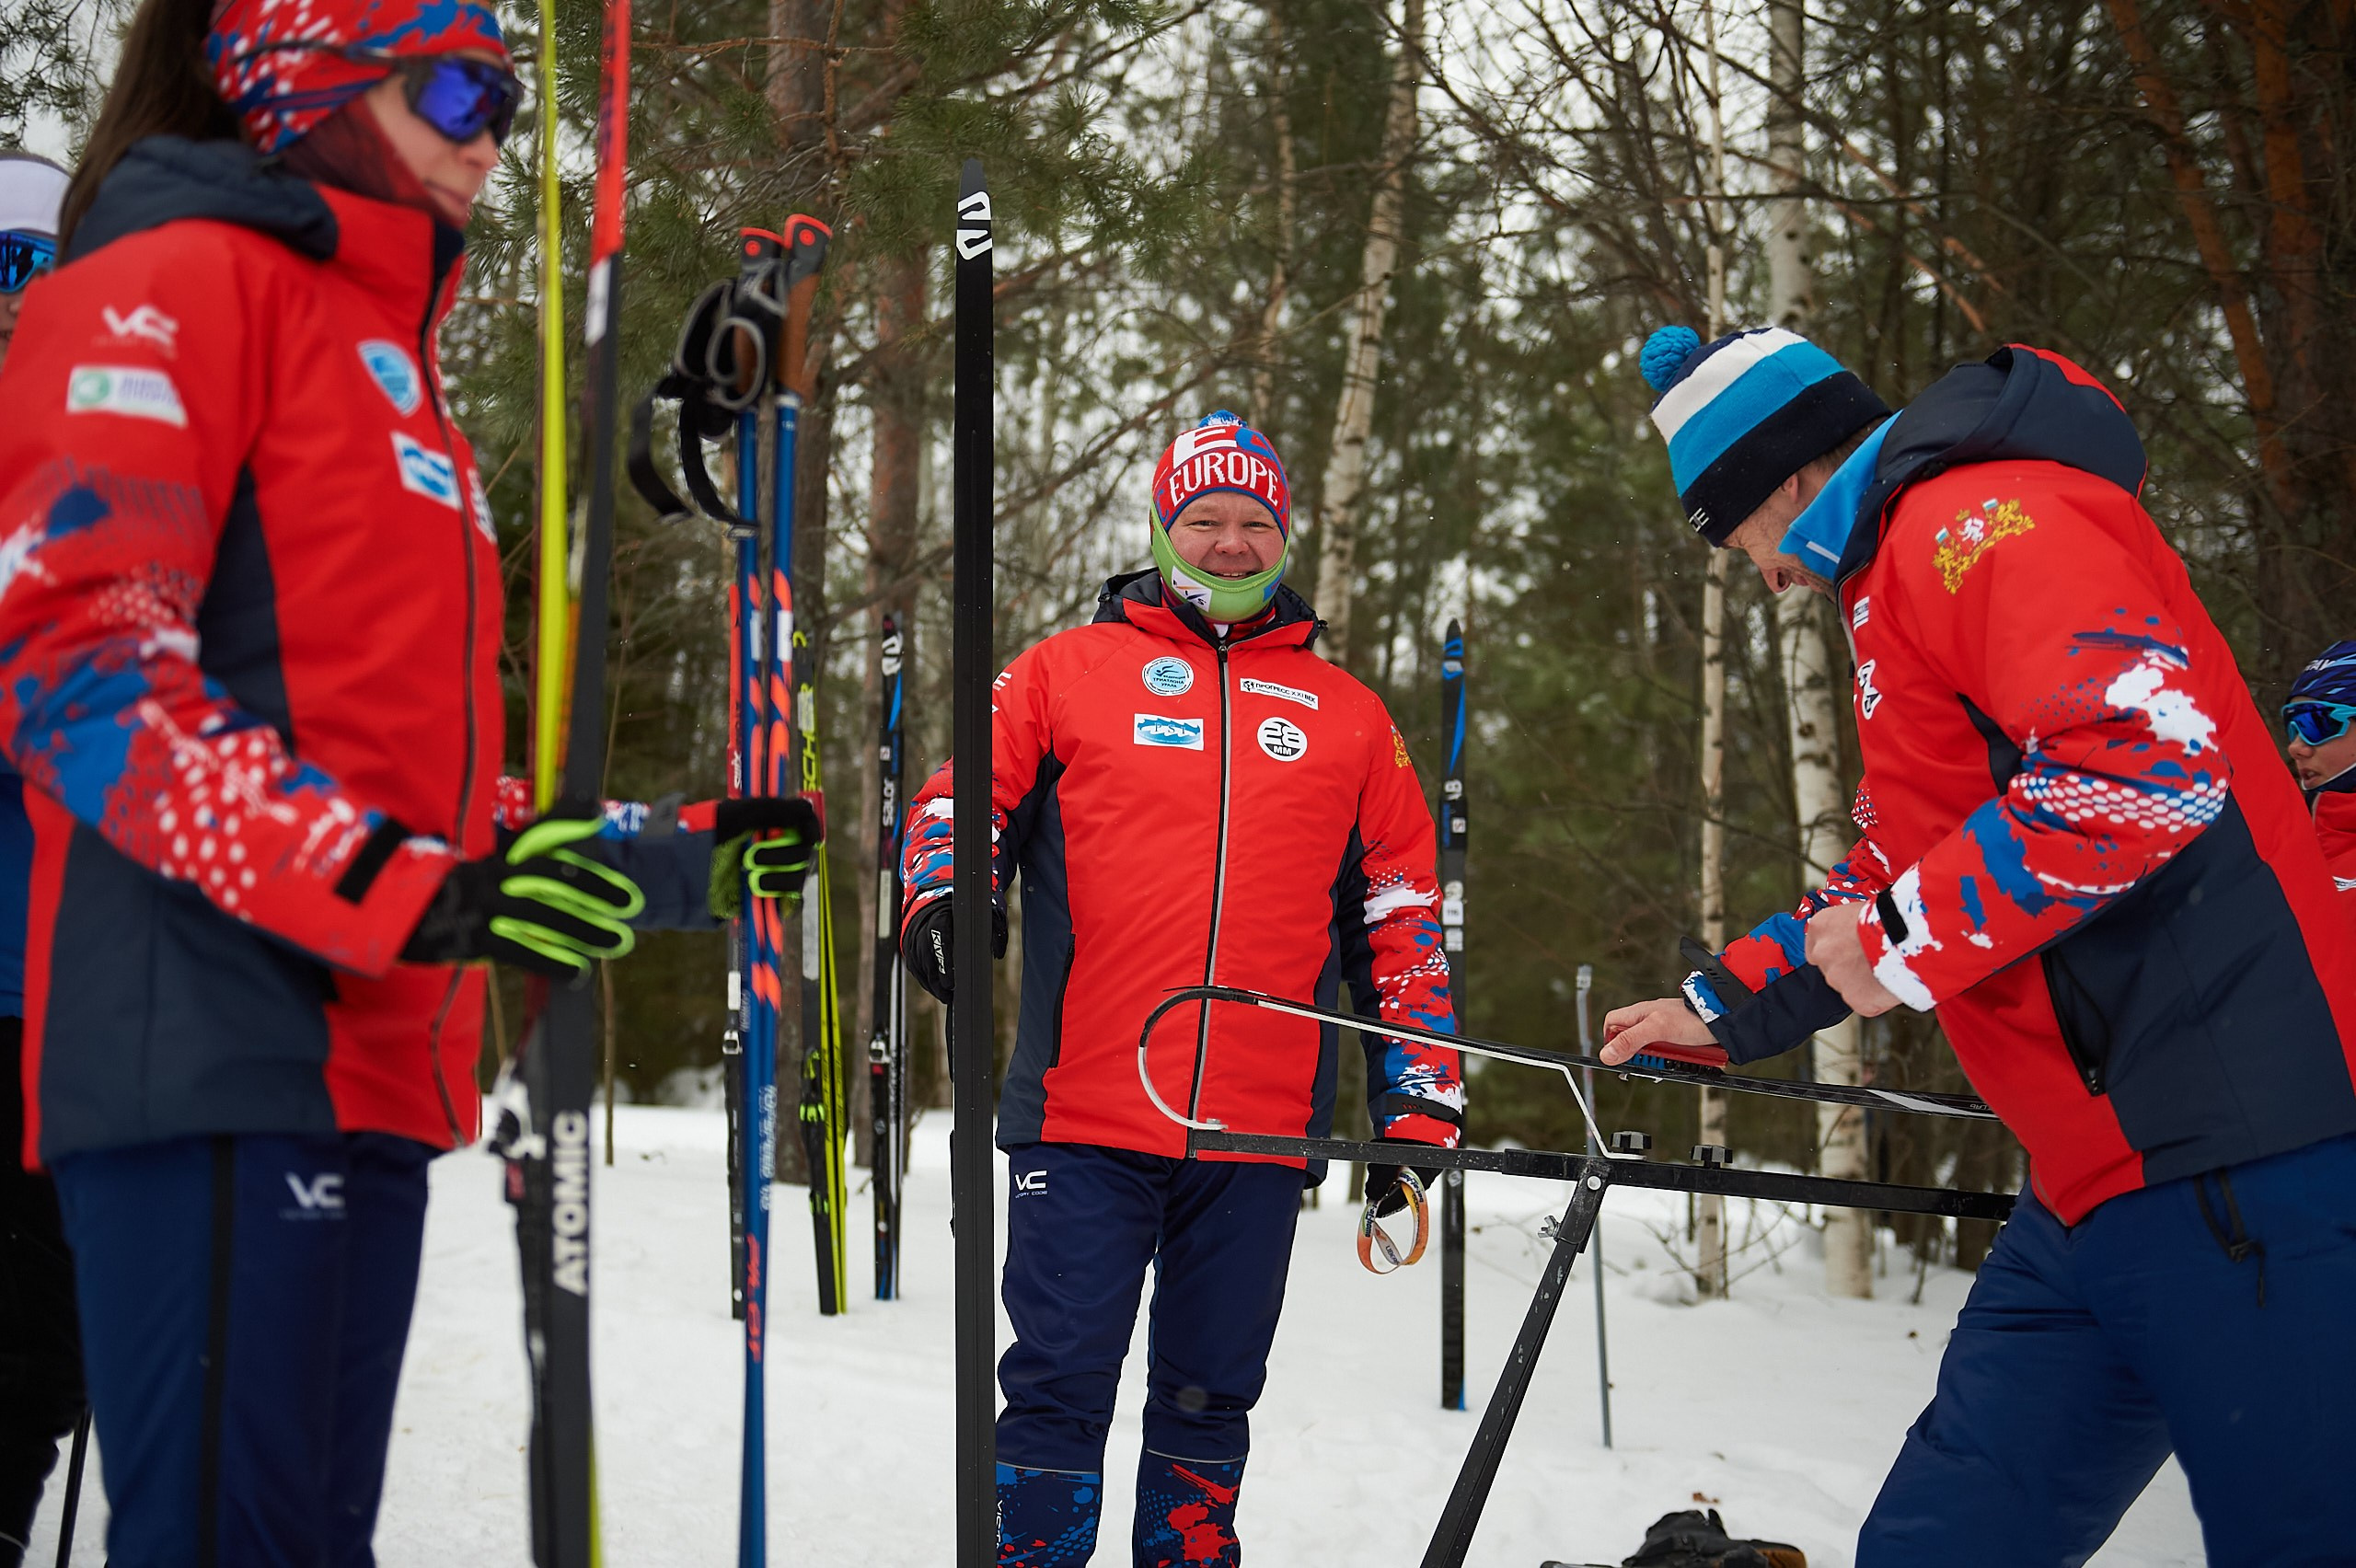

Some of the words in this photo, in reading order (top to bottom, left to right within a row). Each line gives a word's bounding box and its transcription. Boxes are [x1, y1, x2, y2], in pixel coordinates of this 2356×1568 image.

[1169, 451, 1278, 507] EUROPE
[1255, 683, 1289, 695] ПРОГРЕСС
[284, 1171, 345, 1208] VC
[1014, 1170, 1047, 1191] VC
[552, 1110, 589, 1297] ATOMIC
